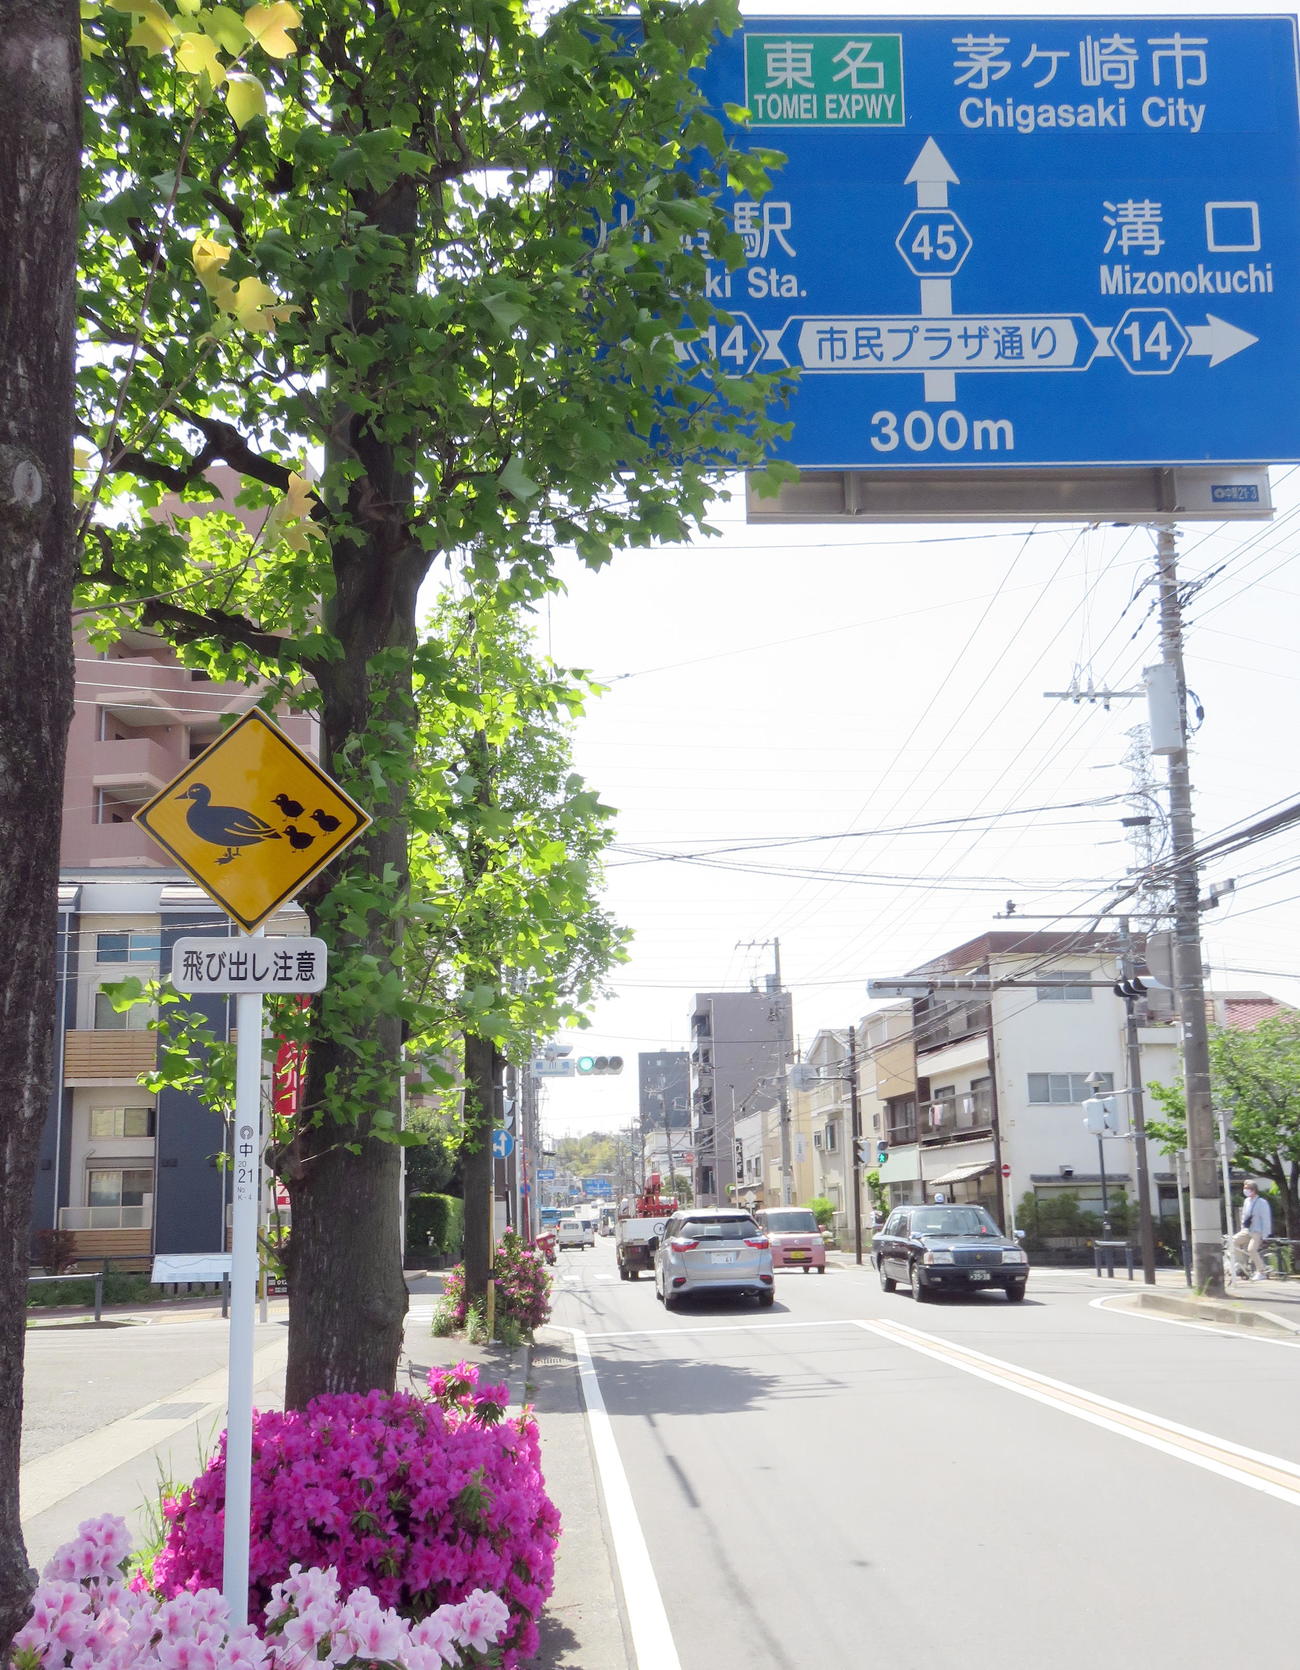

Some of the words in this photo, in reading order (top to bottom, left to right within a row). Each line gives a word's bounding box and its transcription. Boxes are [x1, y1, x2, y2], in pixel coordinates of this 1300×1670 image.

[763, 41, 885, 89] 東名
[754, 94, 817, 119] TOMEI
[825, 94, 896, 119] EXPWY
[959, 97, 1127, 134] Chigasaki
[1141, 96, 1206, 133] City
[912, 224, 958, 261] 45
[1102, 199, 1261, 256] 溝口
[747, 266, 807, 299] Sta.
[1100, 263, 1274, 295] Mizonokuchi
[702, 324, 748, 365] 14
[816, 325, 1057, 362] 市民プラザ通り
[1123, 321, 1172, 362] 14
[870, 410, 1014, 452] 300m
[183, 950, 316, 982] 飛び出し注意
[239, 1142, 253, 1158] 中
[238, 1168, 254, 1184] 21
